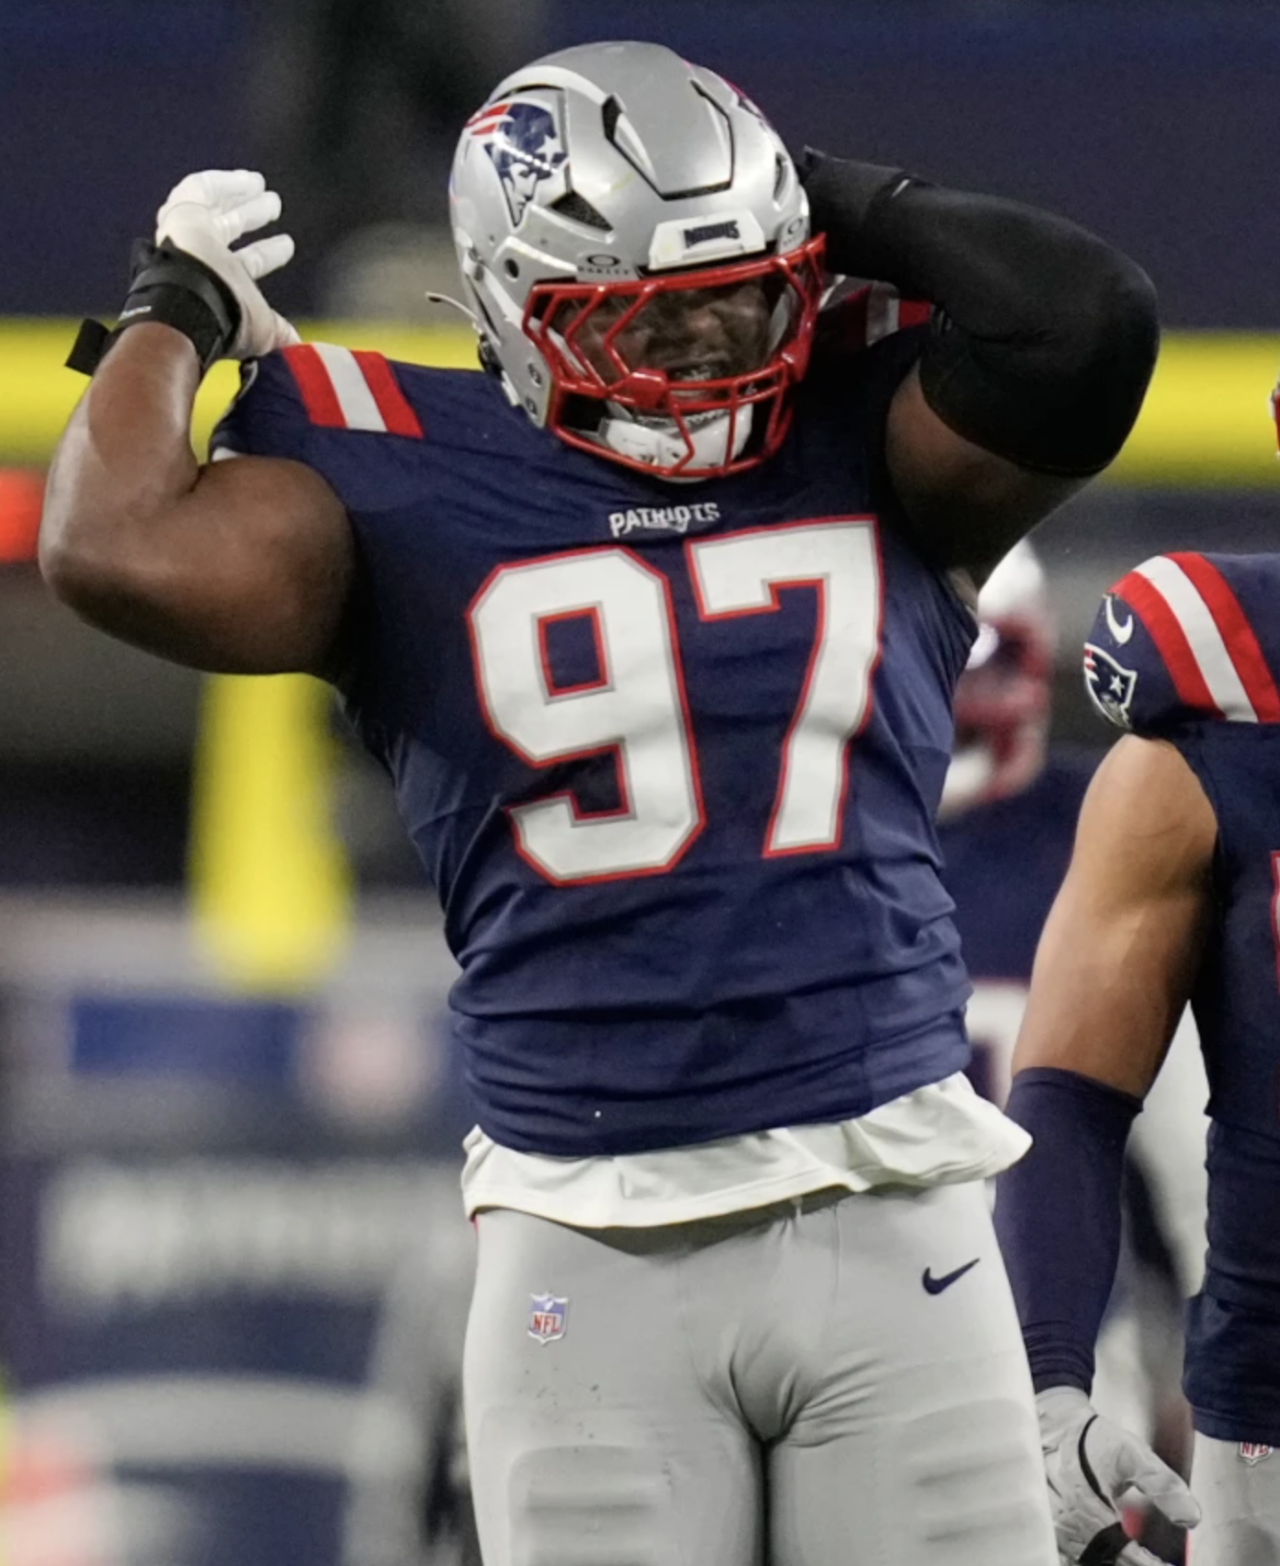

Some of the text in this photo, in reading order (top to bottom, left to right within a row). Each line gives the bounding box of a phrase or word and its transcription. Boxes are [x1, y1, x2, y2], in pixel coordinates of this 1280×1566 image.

[608, 502, 720, 538] PATRIOTS
[466, 514, 882, 886] 97
[533, 1313, 562, 1335] NFL
